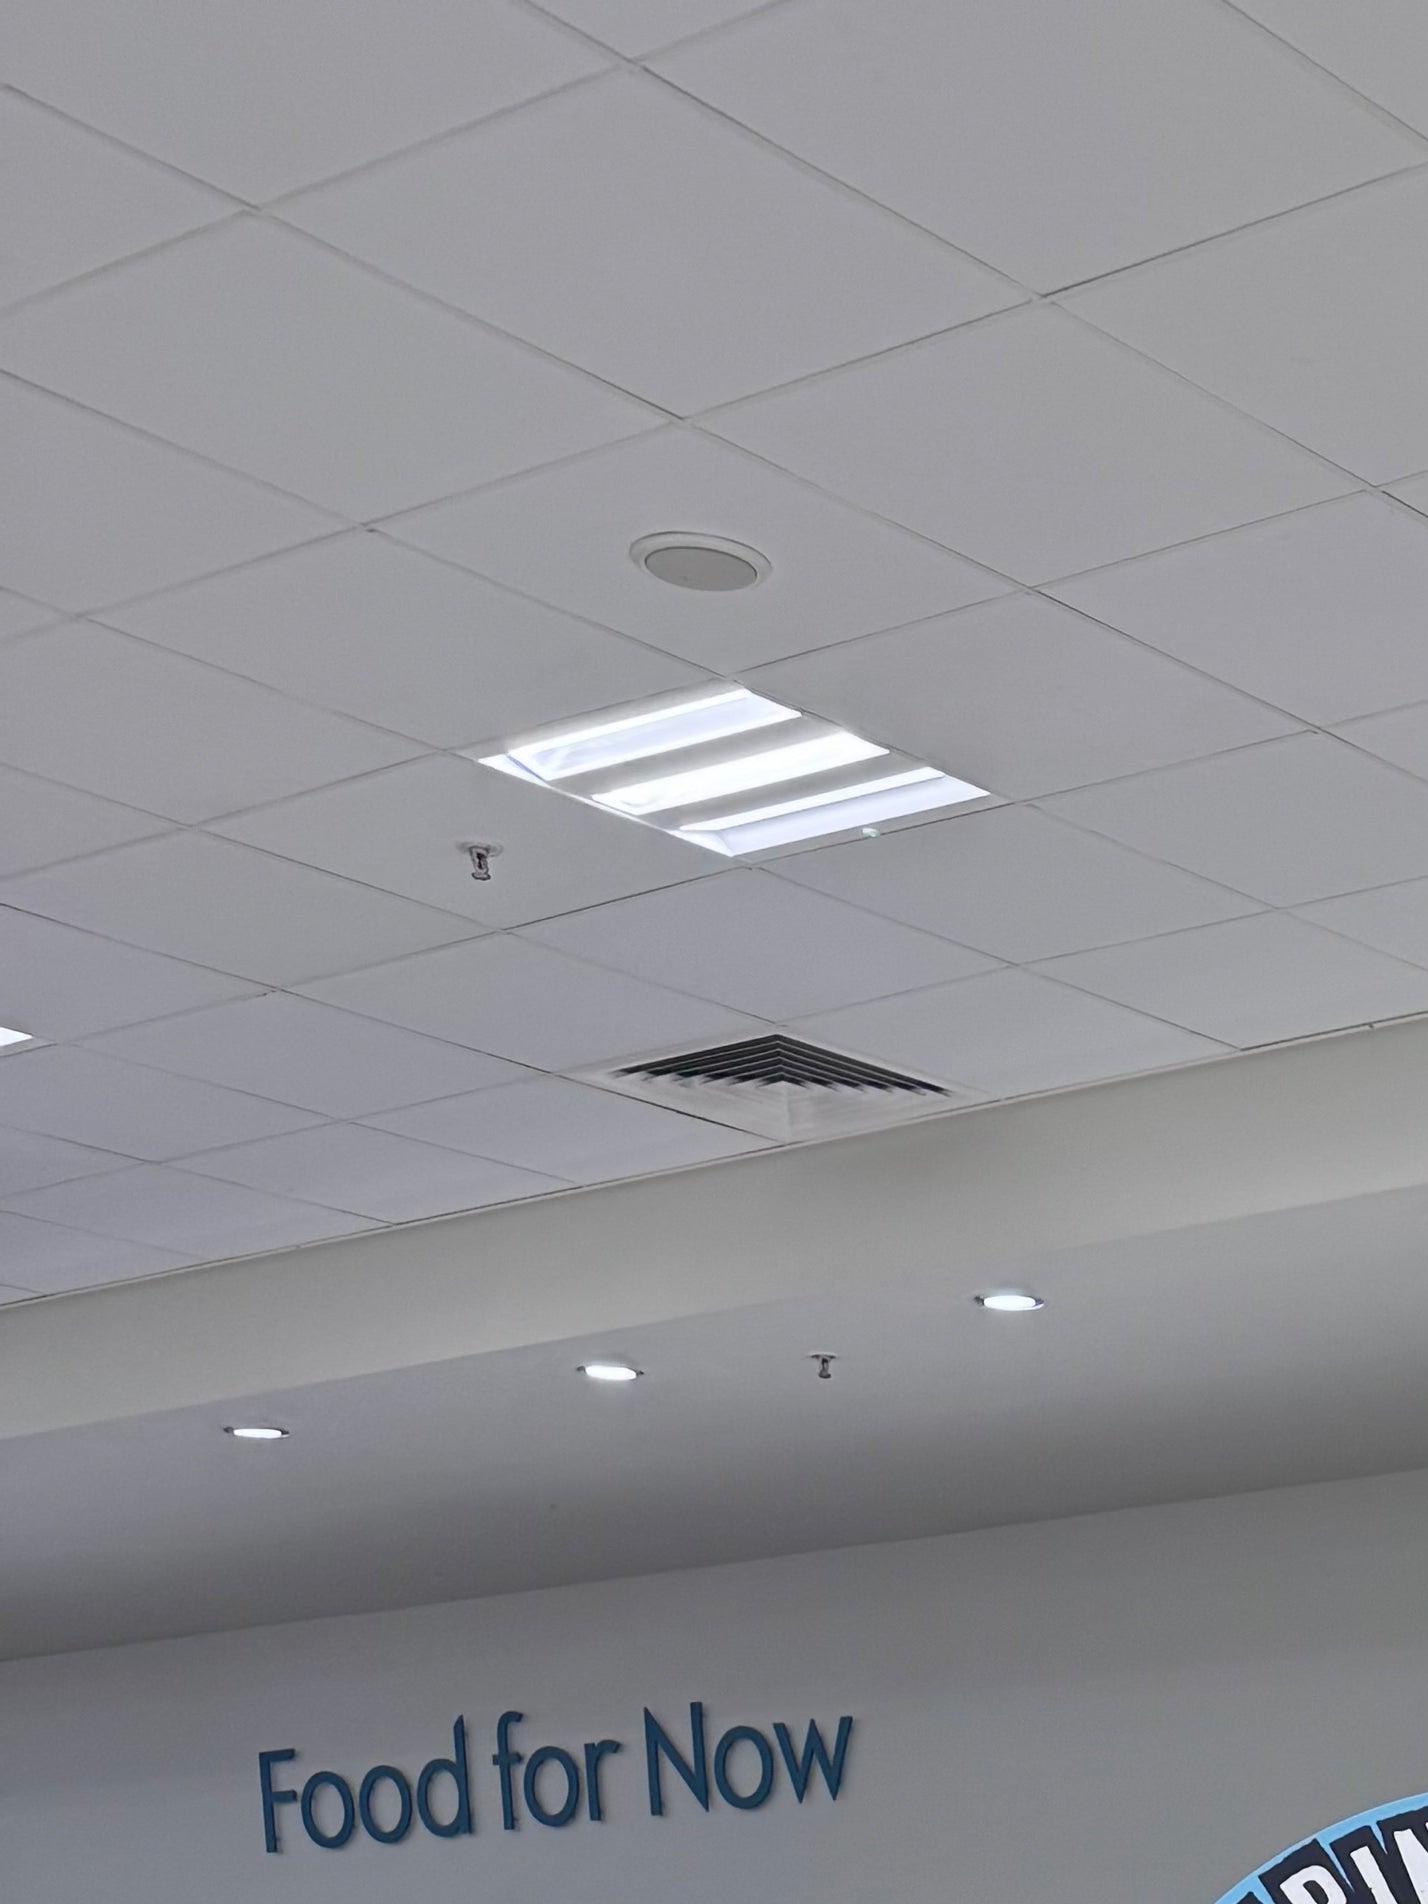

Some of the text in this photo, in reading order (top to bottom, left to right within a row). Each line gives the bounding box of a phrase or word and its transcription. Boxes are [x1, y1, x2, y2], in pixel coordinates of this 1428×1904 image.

[258, 1701, 853, 1853] Food for Now
